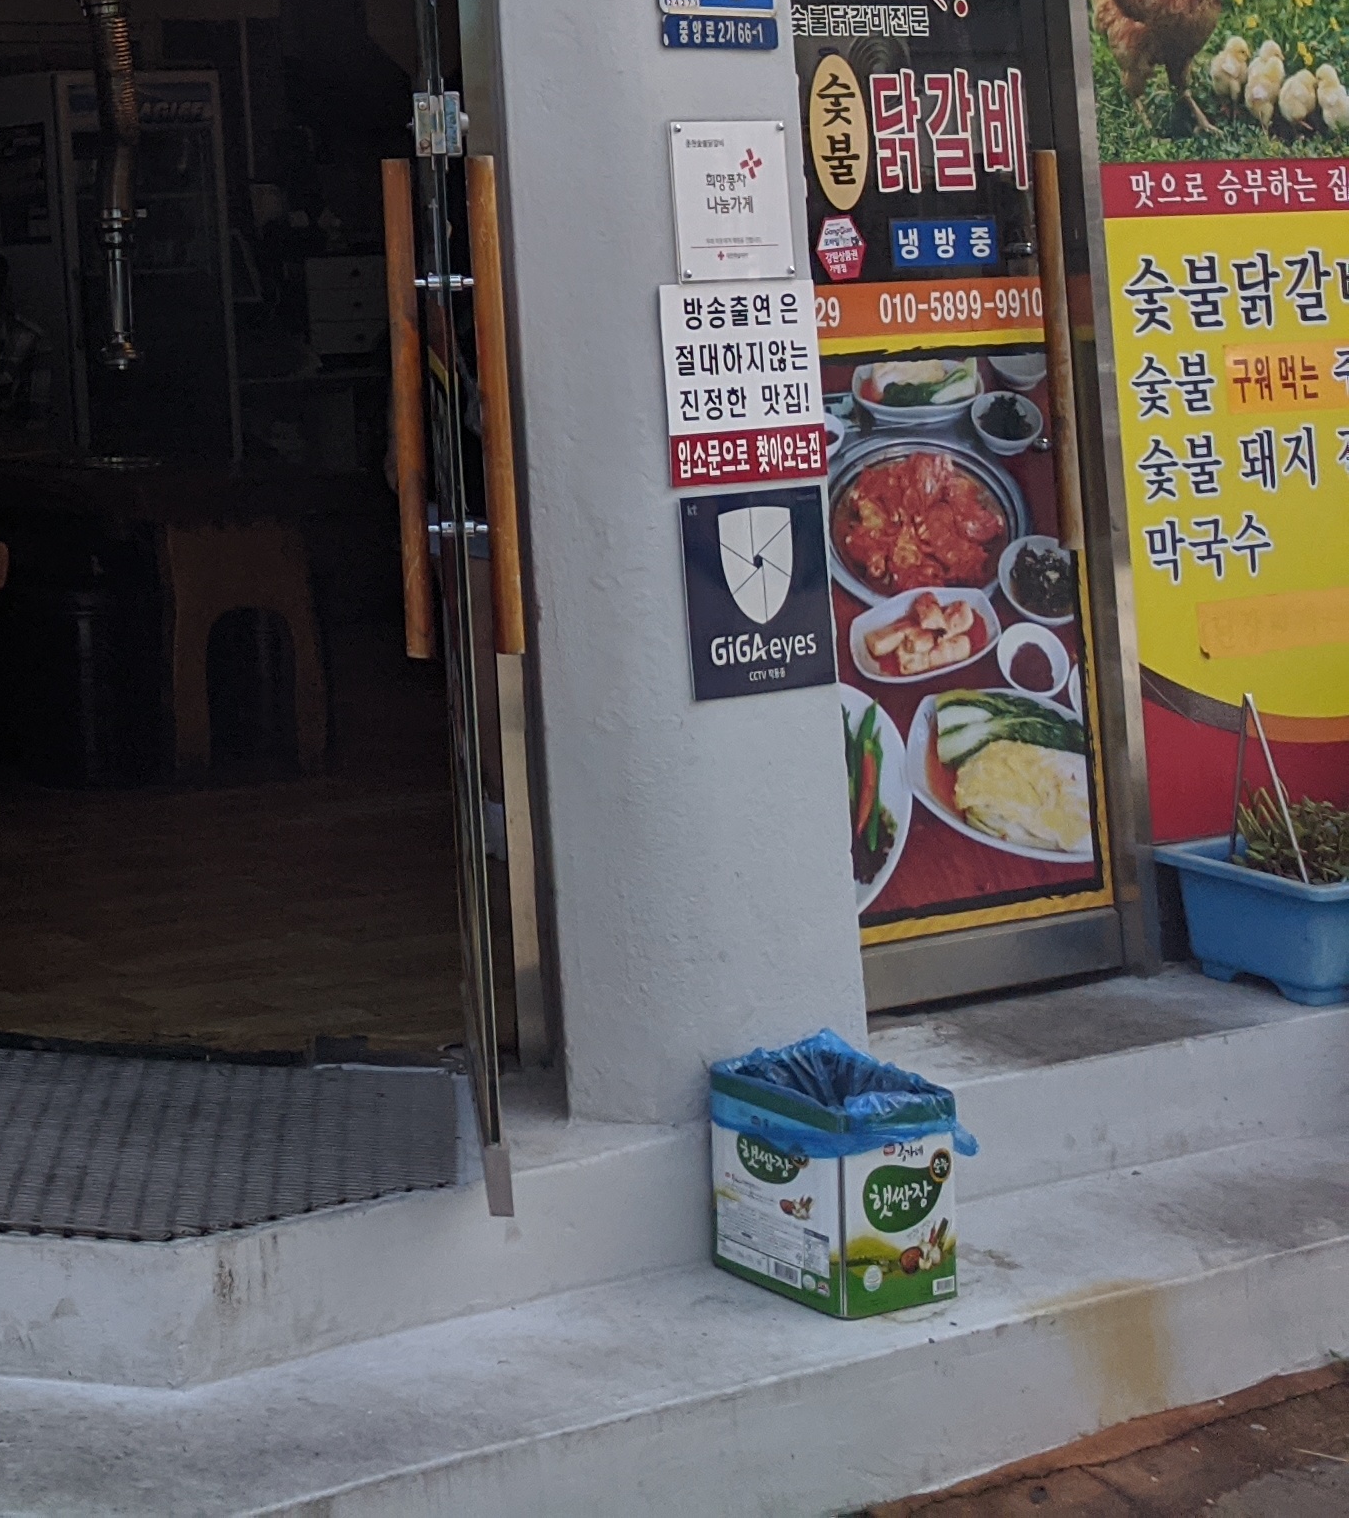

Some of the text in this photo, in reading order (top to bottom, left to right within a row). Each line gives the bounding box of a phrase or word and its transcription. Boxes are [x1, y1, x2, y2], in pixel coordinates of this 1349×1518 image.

[679, 20, 764, 44] 중앙로2가 66-1
[791, 4, 931, 38] 숯불닭갈비전문
[816, 67, 1030, 193] 숯불 닭갈비
[705, 172, 747, 191] 희망풍차
[1129, 170, 1208, 210] 맛으로
[1218, 166, 1319, 207] 승부하는
[706, 195, 754, 214] 나눔가게
[896, 223, 994, 262] 냉방중
[683, 293, 773, 331] 방송출연
[878, 286, 1043, 325] 010-5899-9910
[674, 340, 810, 377] 절대하지않는
[679, 382, 811, 423] 진정한 맛집!
[1130, 351, 1216, 420] 숯불
[1277, 352, 1321, 402] 먹는
[677, 429, 822, 480] 입소문으로 찾아오는집
[1137, 434, 1223, 504] 숯불
[1238, 424, 1321, 494] 돼지
[686, 504, 698, 516] kt
[1144, 513, 1274, 583] 막국수
[868, 1179, 933, 1220] 햇쌈장
